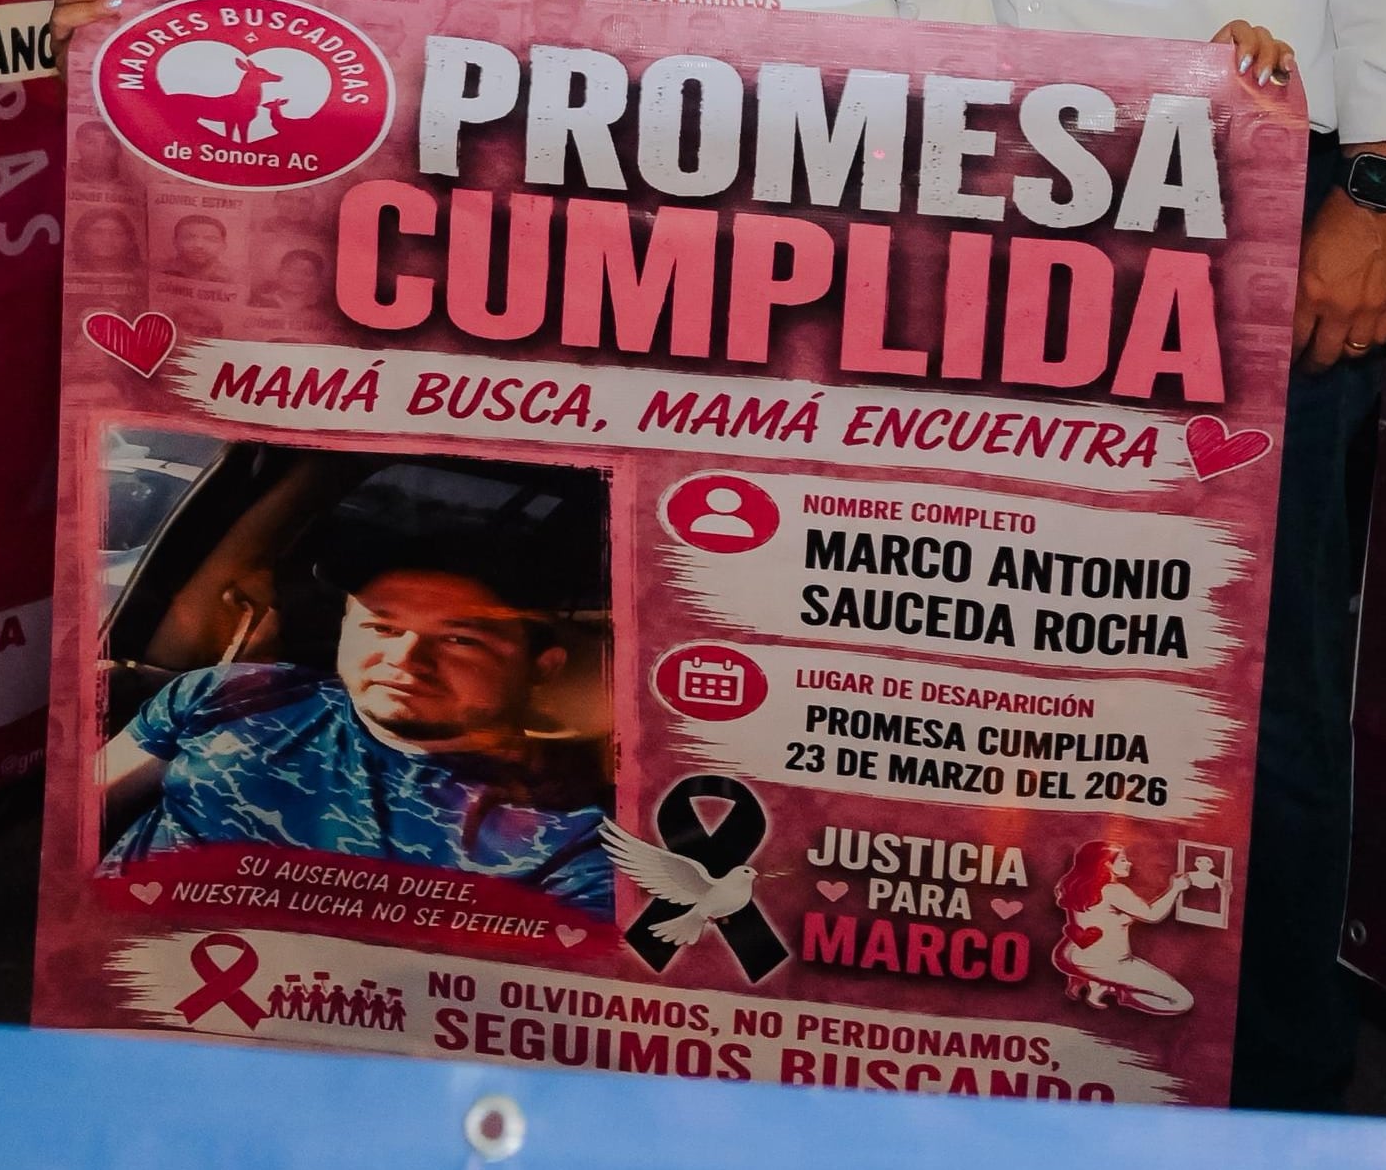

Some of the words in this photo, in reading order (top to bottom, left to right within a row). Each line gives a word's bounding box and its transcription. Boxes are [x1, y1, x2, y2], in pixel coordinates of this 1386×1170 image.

[117, 10, 210, 91] MADRES
[219, 6, 370, 105] BUSCADORAS
[163, 141, 193, 161] de
[199, 144, 281, 169] Sonora
[287, 151, 319, 173] AC
[418, 35, 1228, 239] PROMESA
[334, 178, 1227, 404] CUMPLIDA
[209, 359, 388, 414] MAMÁ
[405, 370, 608, 433] BUSCA,
[637, 390, 822, 436] MAMÁ
[841, 403, 1162, 470] ENCUENTRA
[802, 493, 905, 522] NOMBRE
[910, 502, 1037, 536] COMPLETO
[804, 528, 973, 584] MARCO
[987, 549, 1191, 603] ANTONIO
[799, 583, 1017, 647] SAUCEDA
[1033, 607, 1190, 660] ROCHA
[795, 667, 874, 697] LUGAR
[882, 675, 914, 701] DE
[920, 679, 1096, 719] DESAPARICIÓN
[806, 705, 966, 752] PROMESA
[976, 725, 1149, 765] CUMPLIDA
[785, 741, 825, 774] 23
[835, 747, 877, 780] DE
[887, 756, 1005, 796] MARZO
[1015, 768, 1076, 801] DEL
[1084, 771, 1168, 807] 2026
[236, 854, 268, 877] SU
[274, 860, 391, 894] AUSENCIA
[398, 875, 478, 906] DUELE,
[805, 826, 1028, 888] JUSTICIA
[171, 881, 281, 910] NUESTRA
[287, 892, 365, 920] LUCHA
[372, 901, 408, 925] NO
[412, 905, 443, 929] SE
[449, 910, 550, 941] DETIENE
[866, 878, 973, 921] PARA
[801, 911, 1031, 983] MARCO
[428, 970, 476, 1002] NO
[500, 979, 720, 1037] OLVIDAMOS,
[733, 1008, 784, 1041] NO
[796, 1015, 1061, 1072] PERDONAMOS,
[434, 1007, 753, 1083] SEGUIMOS
